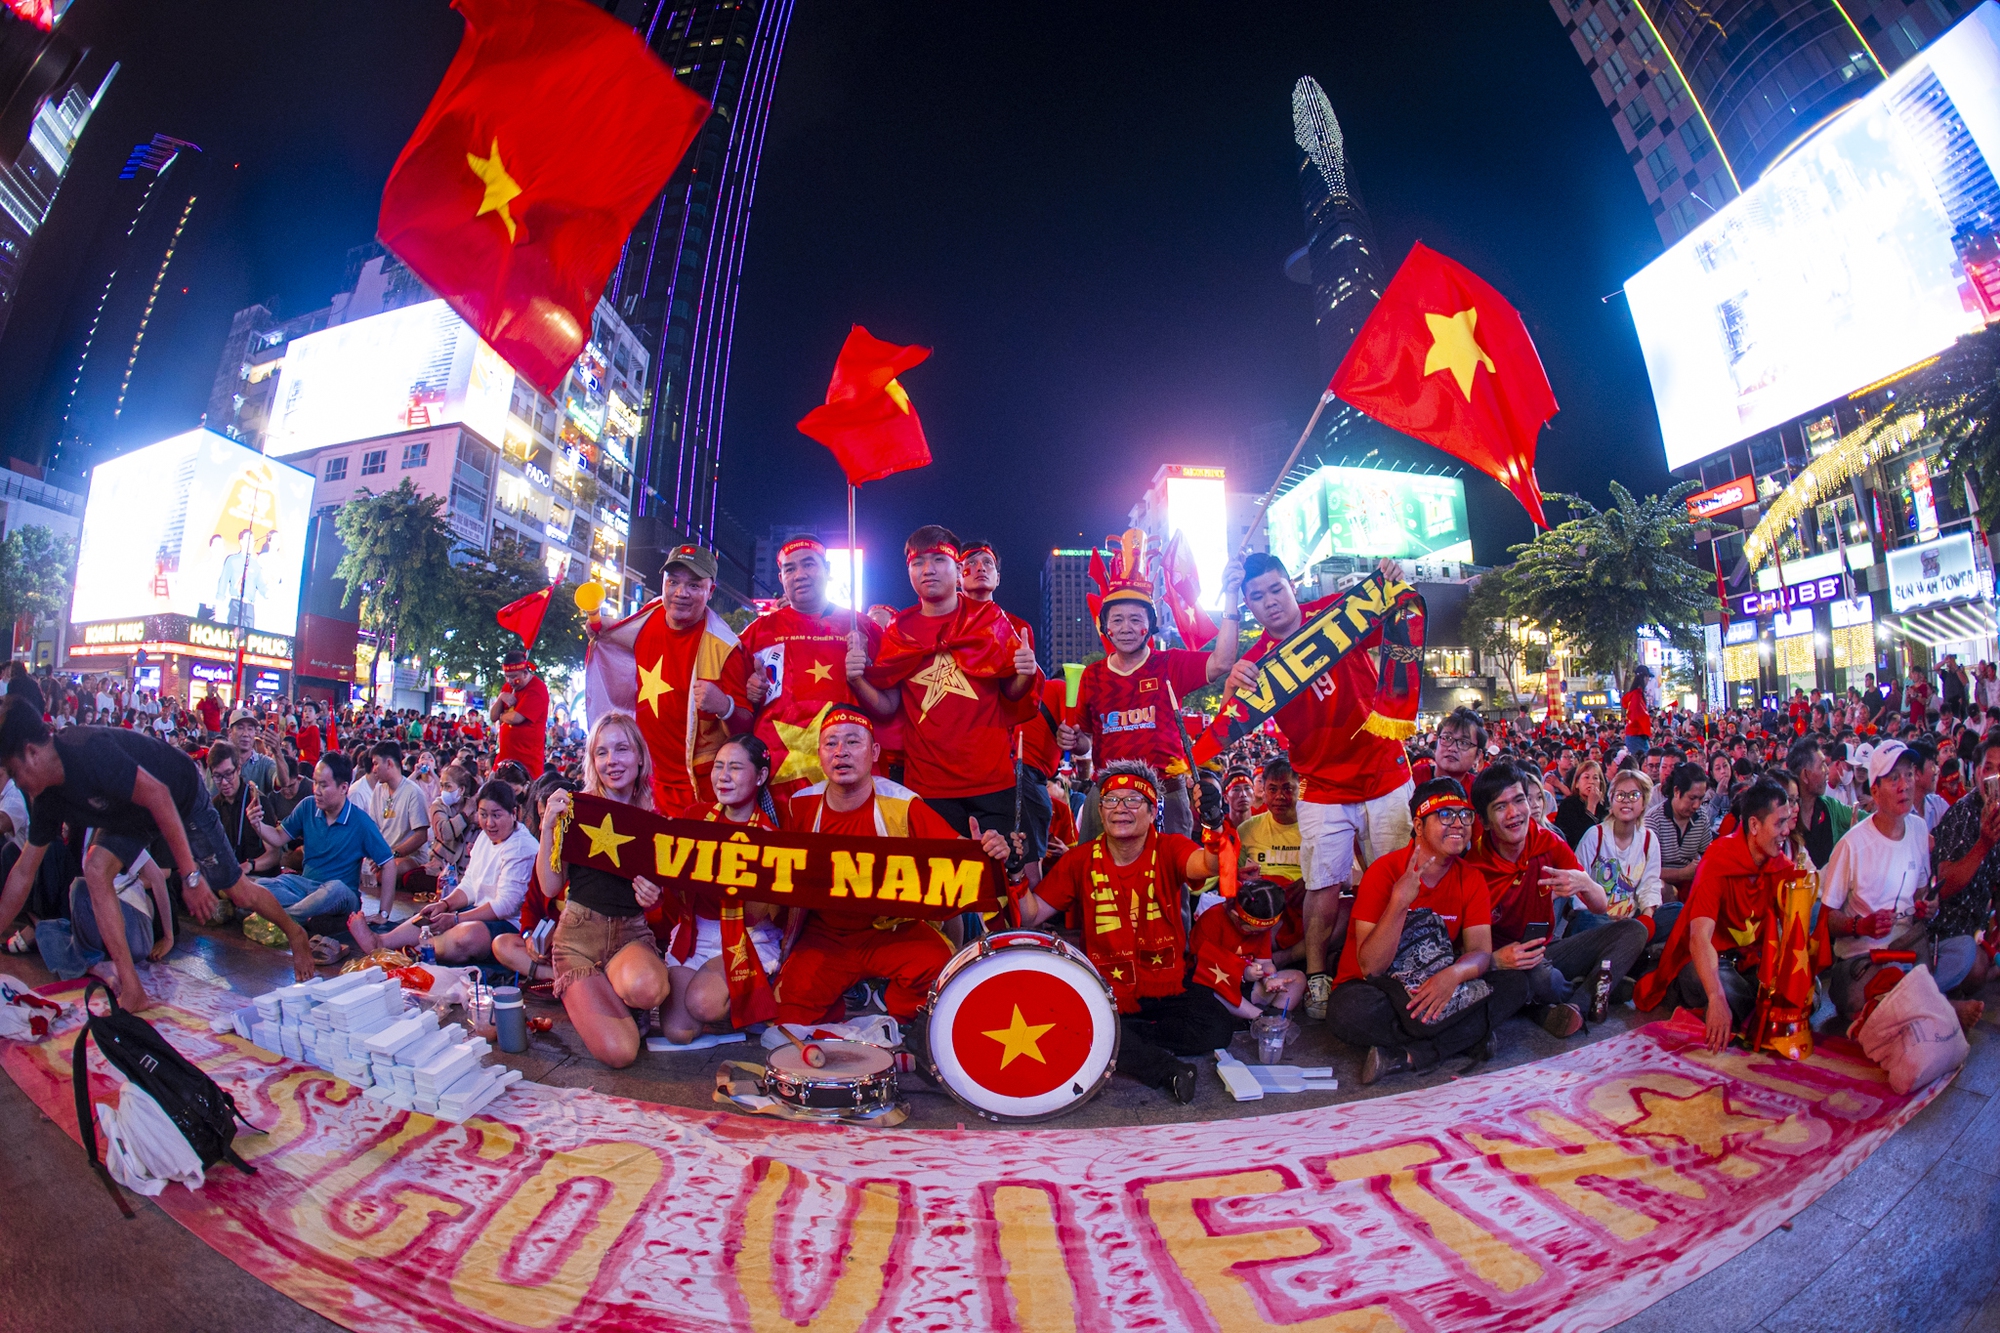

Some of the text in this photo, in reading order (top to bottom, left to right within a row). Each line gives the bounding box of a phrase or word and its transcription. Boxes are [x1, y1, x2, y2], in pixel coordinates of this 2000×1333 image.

[1743, 577, 1837, 614] CHUBB
[1895, 569, 1975, 599] SUN WAH TOWER
[1311, 671, 1337, 701] 19
[1582, 695, 1608, 706] GUTA
[834, 713, 847, 722] VÔ
[1100, 705, 1156, 728] LETOU
[653, 831, 985, 908] VIỆT NAM
